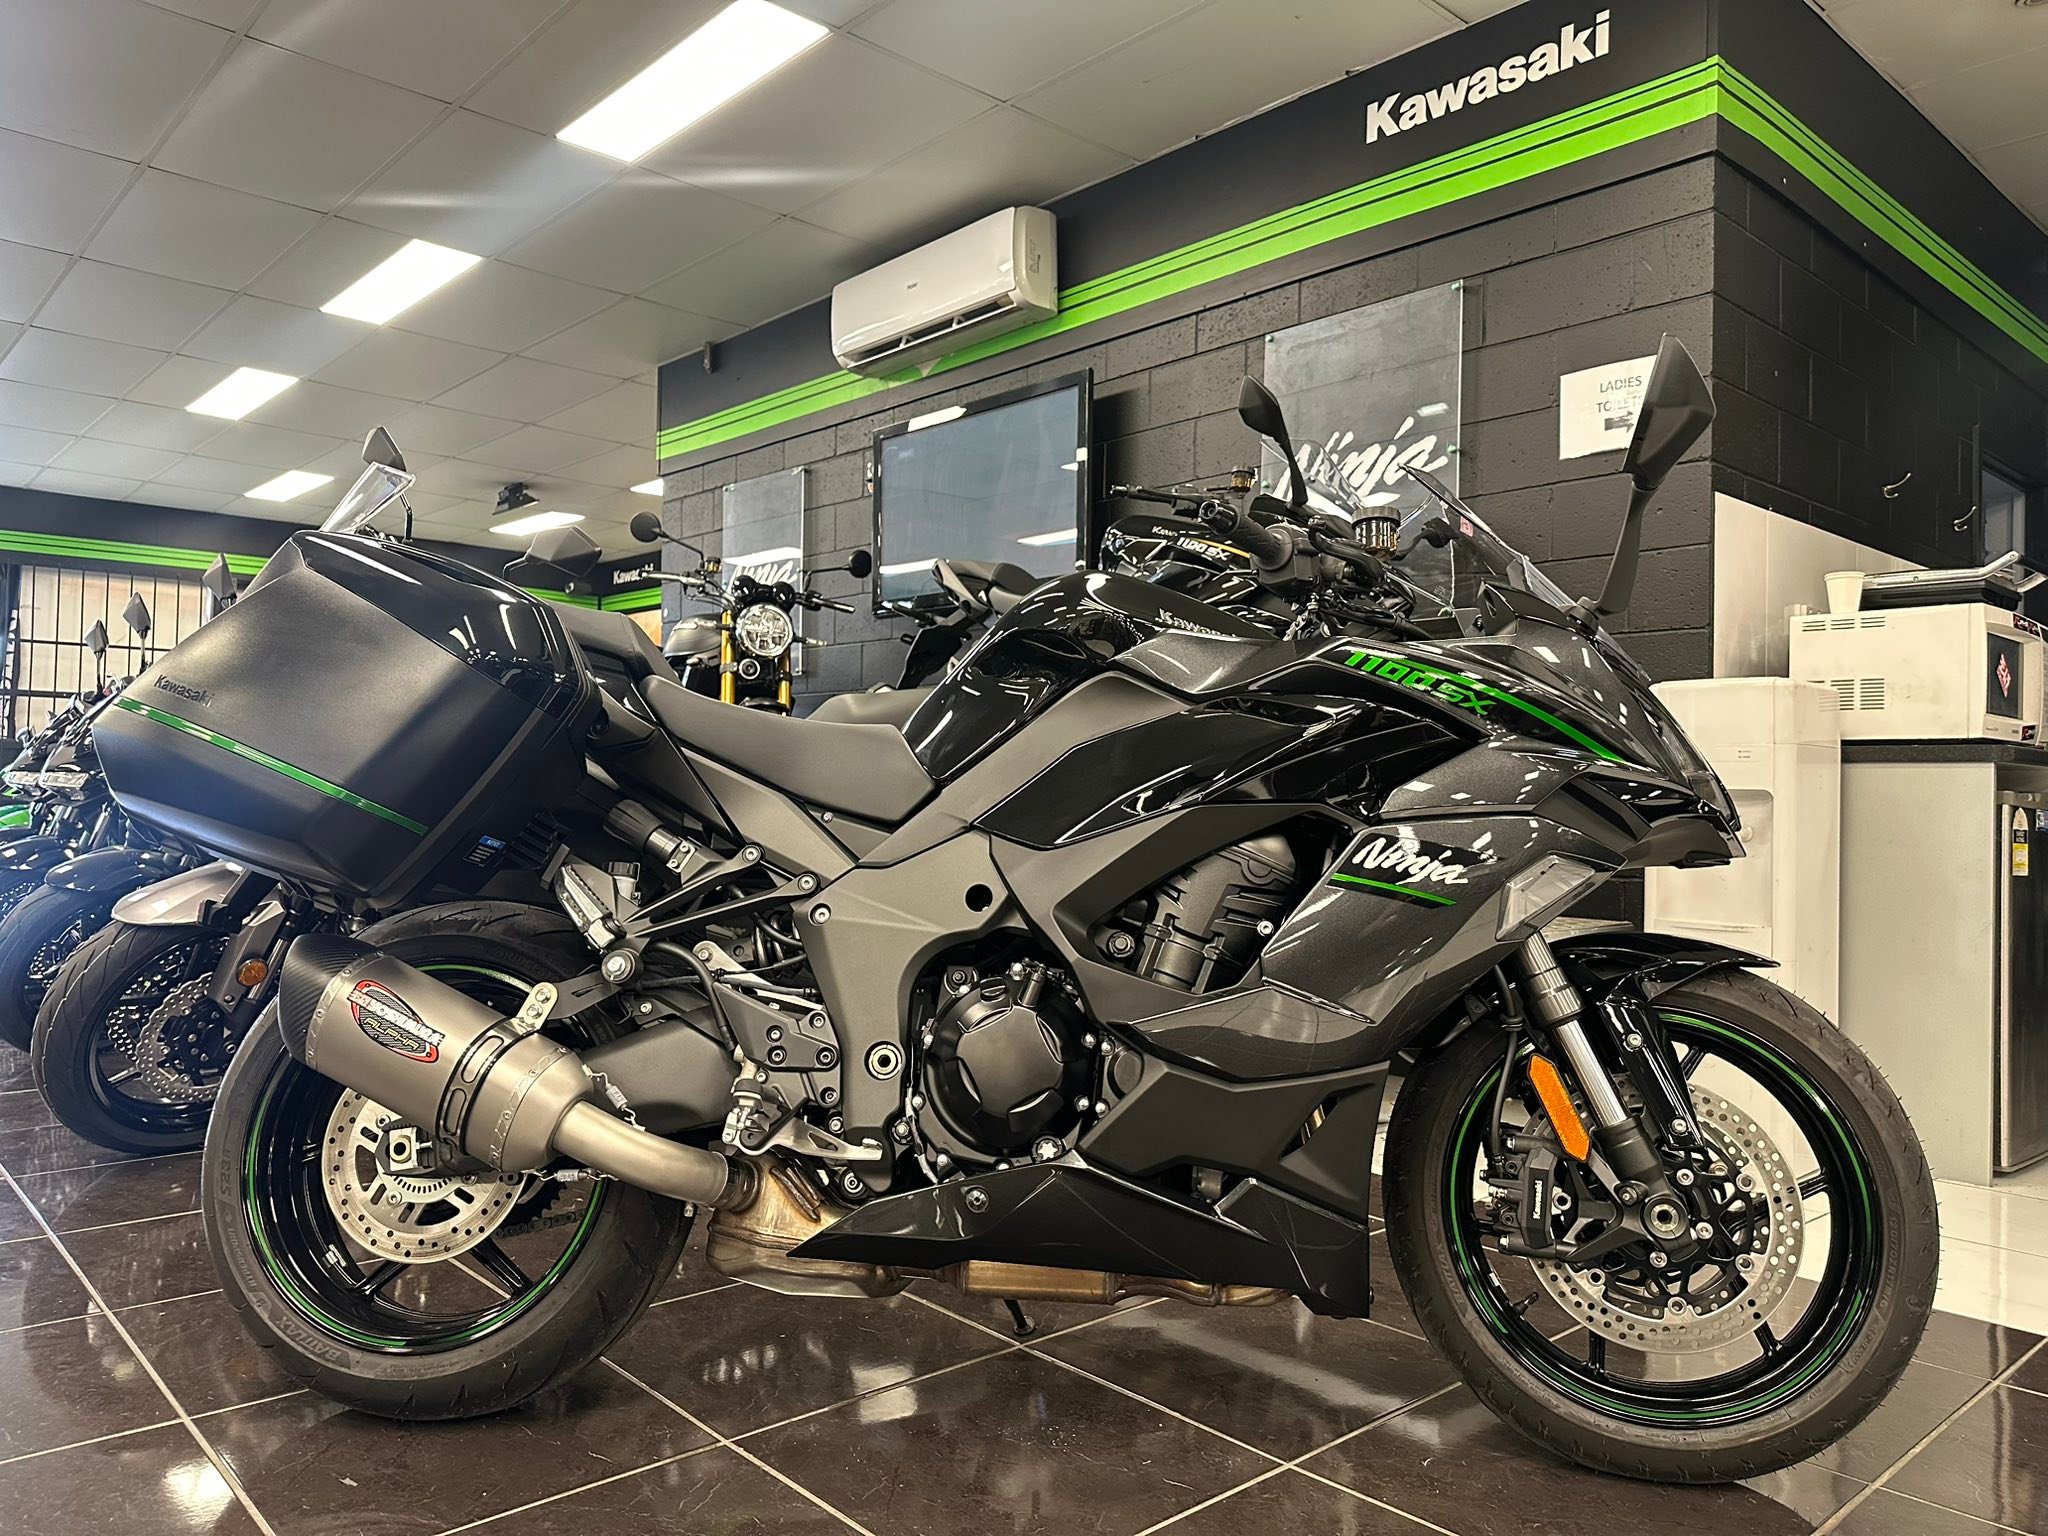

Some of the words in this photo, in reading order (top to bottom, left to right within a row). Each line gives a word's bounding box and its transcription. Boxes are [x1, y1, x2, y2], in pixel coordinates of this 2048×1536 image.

[1365, 9, 1610, 144] Kawasaki
[1600, 376, 1642, 393] LADIES
[613, 562, 654, 585] Kawaki
[153, 674, 215, 708] Kawasaki
[1352, 838, 1468, 886] Ninja
[363, 1017, 420, 1051] ALPHA
[276, 1315, 342, 1361] BATTLAX
